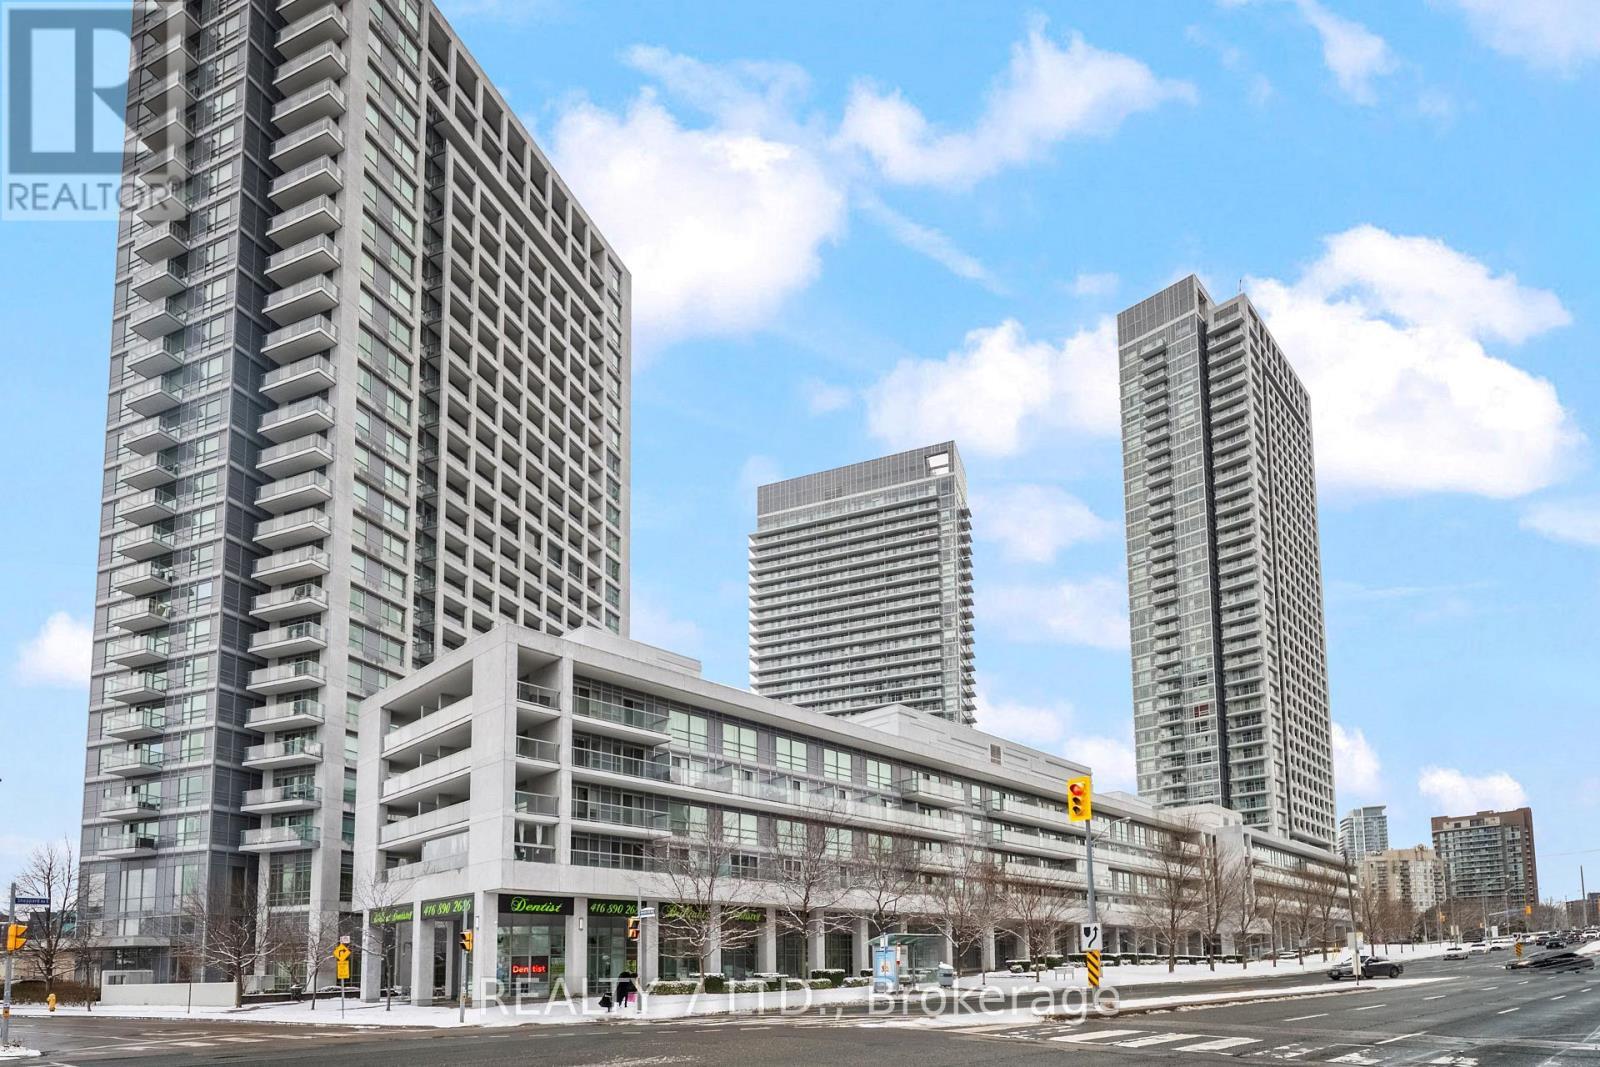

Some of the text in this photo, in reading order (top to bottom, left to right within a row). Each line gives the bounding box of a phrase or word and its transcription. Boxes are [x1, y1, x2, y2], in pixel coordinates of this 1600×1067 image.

[511, 896, 562, 912] Dentist
[590, 903, 606, 912] 416
[424, 904, 436, 916] 416
[512, 964, 546, 973] Dentist
